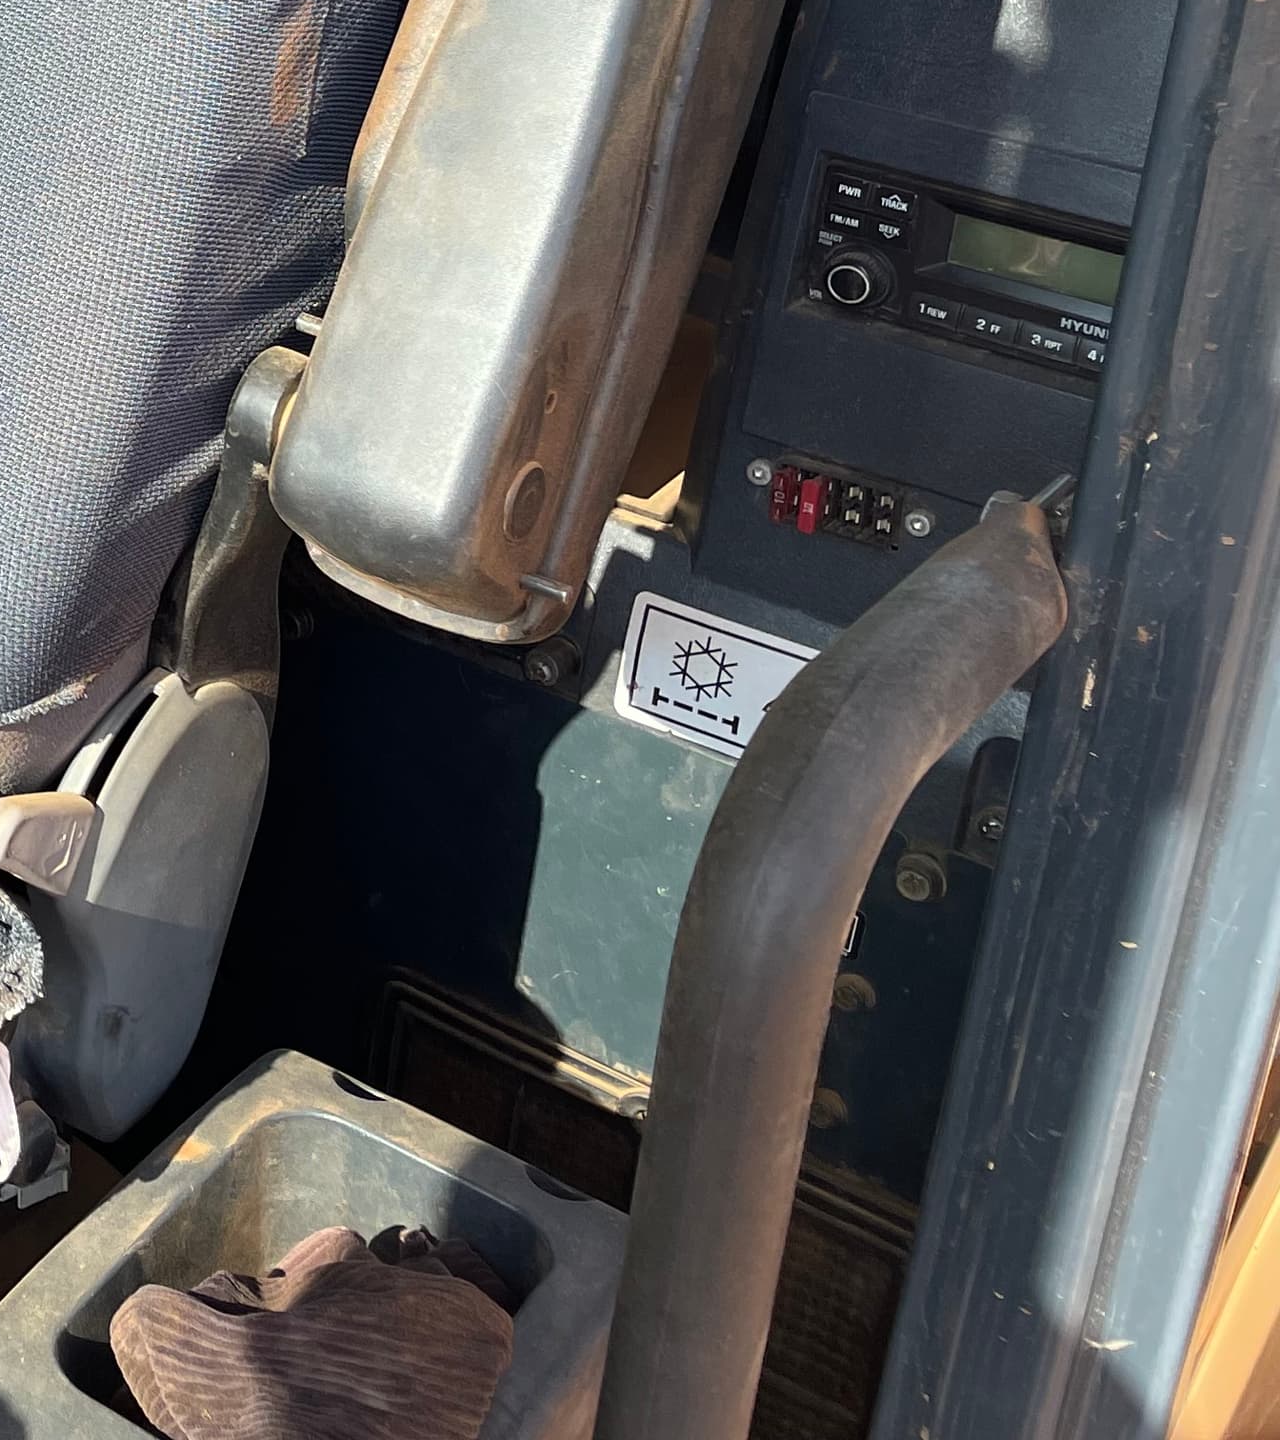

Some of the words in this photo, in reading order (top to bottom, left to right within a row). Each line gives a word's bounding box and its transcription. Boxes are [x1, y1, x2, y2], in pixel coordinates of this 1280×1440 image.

[838, 183, 862, 198] PWR
[880, 196, 908, 212] TRACK
[829, 213, 860, 228] FM/AM
[878, 223, 901, 237] SEEK
[919, 303, 925, 314] 1
[926, 306, 947, 320] REW
[975, 318, 986, 331] 2
[989, 324, 1002, 335] FF
[1031, 334, 1041, 346] 3
[1044, 338, 1063, 352] RPT
[1087, 349, 1097, 361] 4
